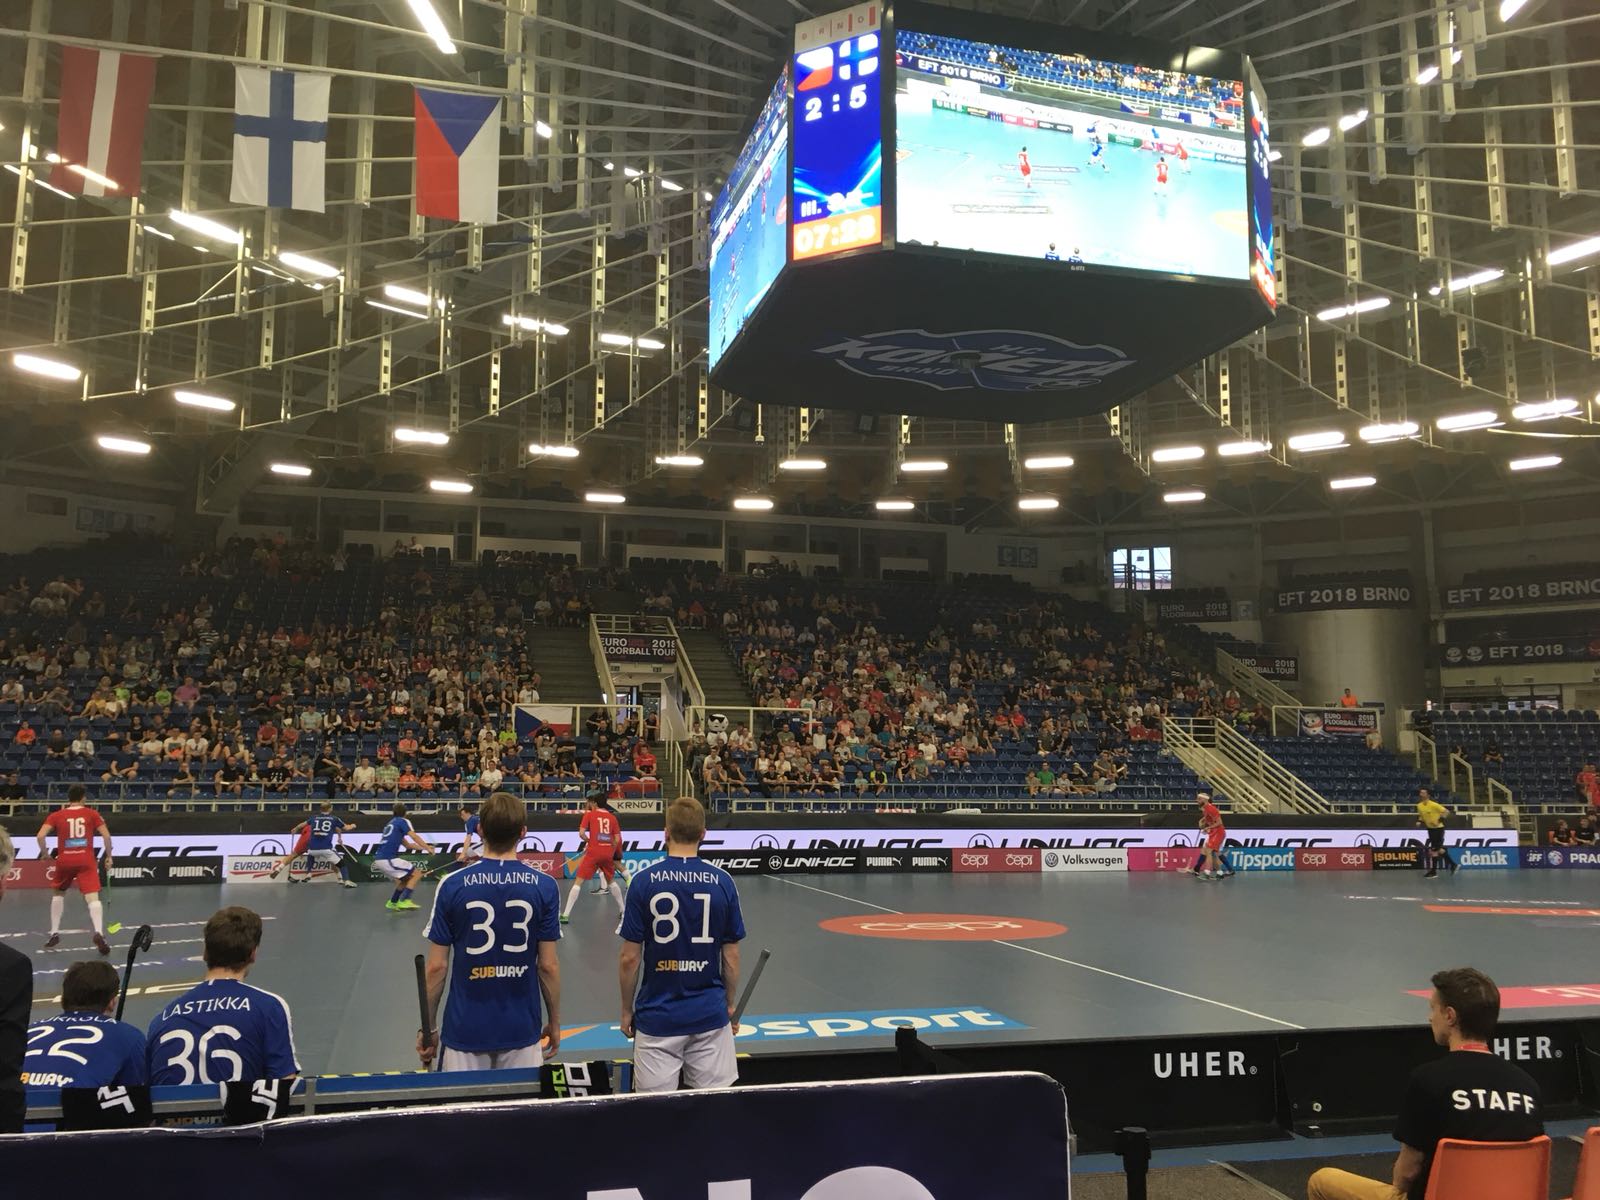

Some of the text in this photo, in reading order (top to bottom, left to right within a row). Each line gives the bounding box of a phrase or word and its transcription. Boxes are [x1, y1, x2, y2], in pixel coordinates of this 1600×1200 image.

[918, 60, 939, 71] EFT
[805, 97, 822, 121] 2
[849, 84, 867, 109] 5
[1278, 585, 1411, 607] EFT 2018 BRNO
[1447, 587, 1483, 604] EFT
[1489, 584, 1541, 601] 2018
[1160, 602, 1228, 612] EURO 2018
[603, 646, 651, 656] LOORBALL
[1489, 644, 1564, 659] EFT 2018
[1275, 660, 1296, 668] 2018
[1276, 667, 1296, 675] TOUR
[1324, 712, 1342, 720] EURO
[1324, 719, 1357, 727] FLOORBALL
[617, 801, 654, 810] KRNOV
[67, 817, 86, 838] 16
[313, 819, 332, 832] 18
[597, 817, 610, 834] 13
[783, 856, 857, 867] UNIHOC
[866, 856, 893, 867] PUMA
[912, 856, 938, 867] PUMA
[1062, 854, 1123, 867] Volkswagen
[1231, 851, 1294, 870] Tipsport
[1374, 852, 1417, 862] ISOLINE
[1460, 850, 1508, 866] deník
[169, 865, 203, 877] PUMA
[650, 870, 720, 885] MANNINEN
[463, 871, 539, 887] KAINULAINEN
[649, 892, 715, 944] 81
[465, 899, 533, 955] 33
[469, 964, 529, 981] SUBWAY
[655, 960, 709, 973] SUBWAY
[162, 996, 251, 1021] LASTIKKA
[25, 1025, 104, 1066] 22
[160, 1025, 243, 1086] 36
[1452, 1088, 1535, 1115] STAFF
